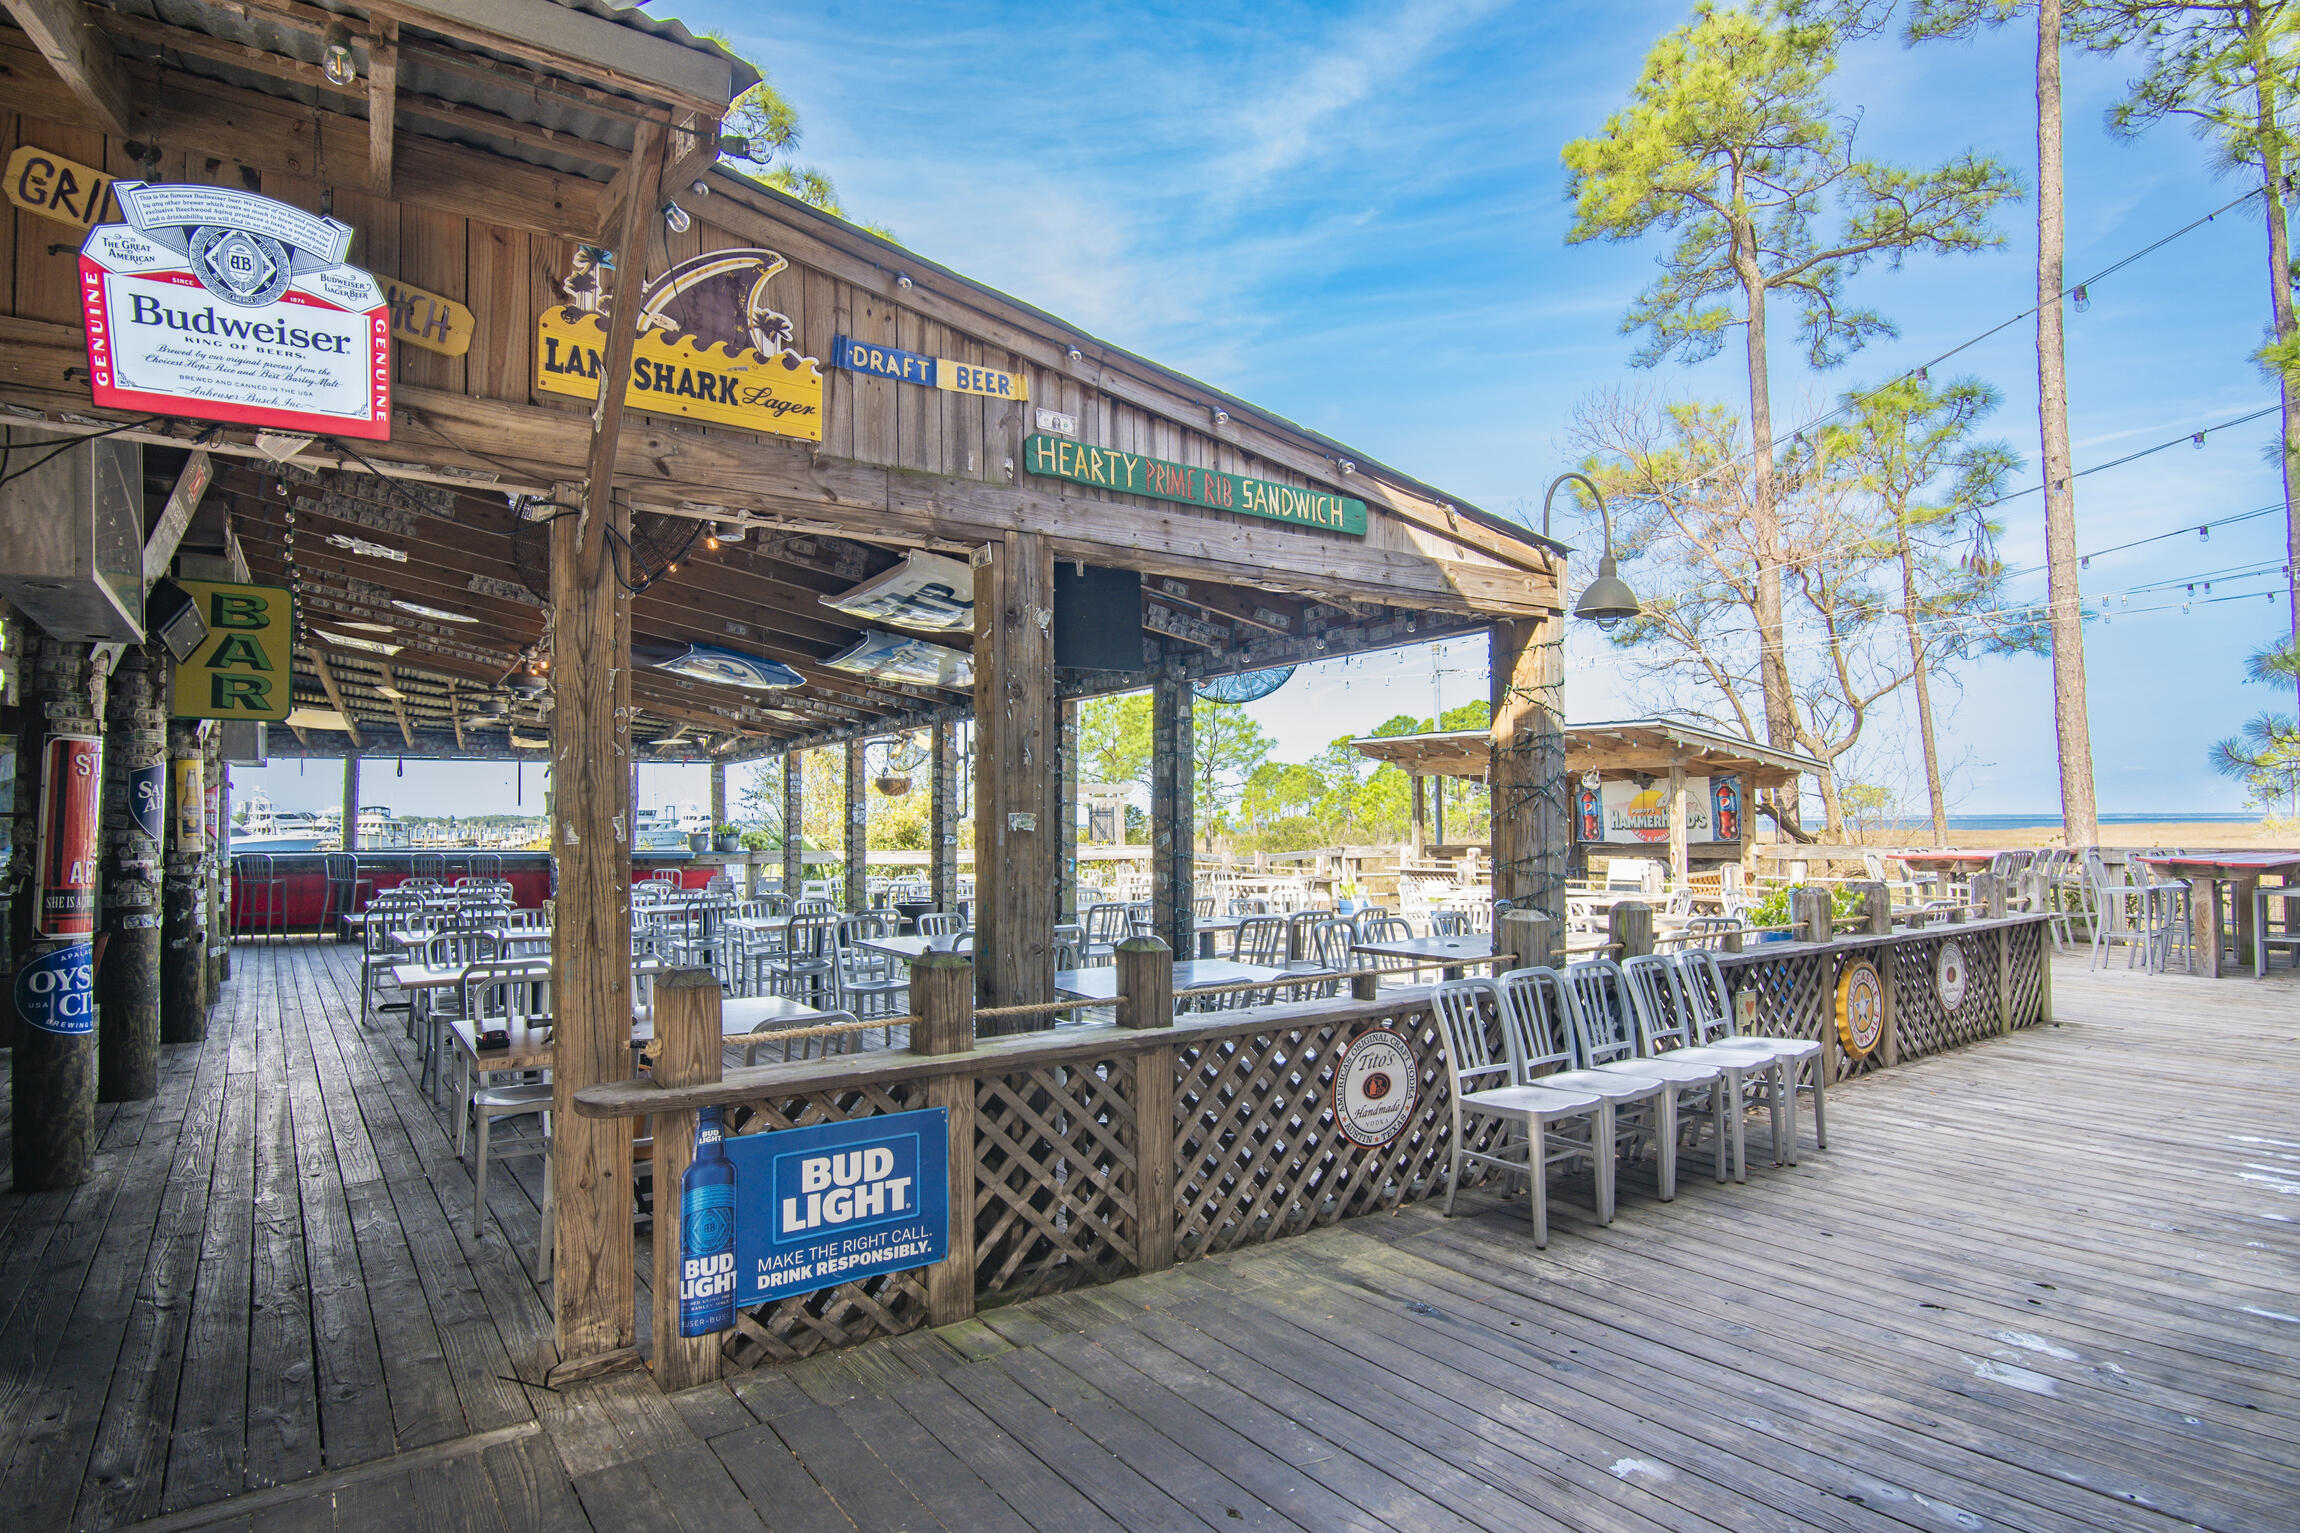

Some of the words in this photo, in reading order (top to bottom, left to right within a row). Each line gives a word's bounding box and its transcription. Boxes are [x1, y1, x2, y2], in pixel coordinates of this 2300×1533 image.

[102, 237, 120, 248] THE
[121, 240, 151, 252] GREAT
[109, 248, 155, 262] AMERICAN
[172, 277, 194, 286] SINCE
[320, 273, 366, 290] BUDWEISER
[324, 283, 350, 297] LAGER
[349, 289, 369, 300] BEER
[85, 272, 109, 386] GENUINE
[128, 293, 351, 354] Budweiser
[153, 344, 192, 356] Brewed
[194, 350, 206, 360] by
[226, 357, 261, 367] original
[262, 360, 292, 371] process
[294, 364, 316, 374] from
[184, 336, 222, 347] KING
[256, 347, 306, 359] BEERS.
[143, 352, 184, 366] Choicest
[214, 363, 236, 374] Rice
[258, 369, 280, 380] Best
[283, 373, 314, 387] Barley
[315, 378, 340, 388] Malt
[374, 319, 387, 422] GENUINE
[545, 336, 739, 406] LANSHARK
[742, 386, 816, 418] Lager
[852, 346, 930, 382] DRAFT
[956, 366, 1010, 396] BEER
[178, 374, 214, 384] BREWED
[234, 382, 268, 391] CANNED
[298, 389, 314, 397] USA
[1038, 436, 1138, 488] HEARTY
[1145, 458, 1196, 500] PRIME
[1204, 472, 1233, 508] RIB
[1242, 480, 1344, 528] SANDWICH
[204, 592, 275, 712] BAR
[74, 752, 102, 776] ST
[138, 780, 163, 798] SA
[1610, 808, 1708, 830] HAMMERHD'S
[68, 860, 96, 884] AR
[46, 896, 64, 909] SHE
[66, 896, 75, 908] IS
[46, 1018, 88, 1028] BREWING
[1870, 1011, 1880, 1035] ALE
[1351, 1034, 1388, 1056] ORIGINAL
[1390, 1036, 1412, 1064] CRAFT
[1407, 1064, 1416, 1100] VODKA
[1358, 1050, 1396, 1072] Tito's
[1353, 1098, 1400, 1120] Handmade
[698, 1136, 722, 1144] LIGHT
[702, 1130, 719, 1138] BUD
[1344, 1122, 1373, 1144] AUSTIN
[1381, 1114, 1407, 1140] TEXAS
[802, 1147, 894, 1194] BUD
[782, 1176, 912, 1233] LIGHT
[758, 1246, 804, 1273] MAKE
[808, 1241, 838, 1260] THE
[843, 1230, 887, 1253] RIGHT
[891, 1225, 933, 1242] CALL.
[685, 1252, 734, 1280] BUD
[757, 1266, 813, 1290] DRINK
[816, 1240, 932, 1276] RESPONSIBLY.
[680, 1270, 738, 1300] LIGHT
